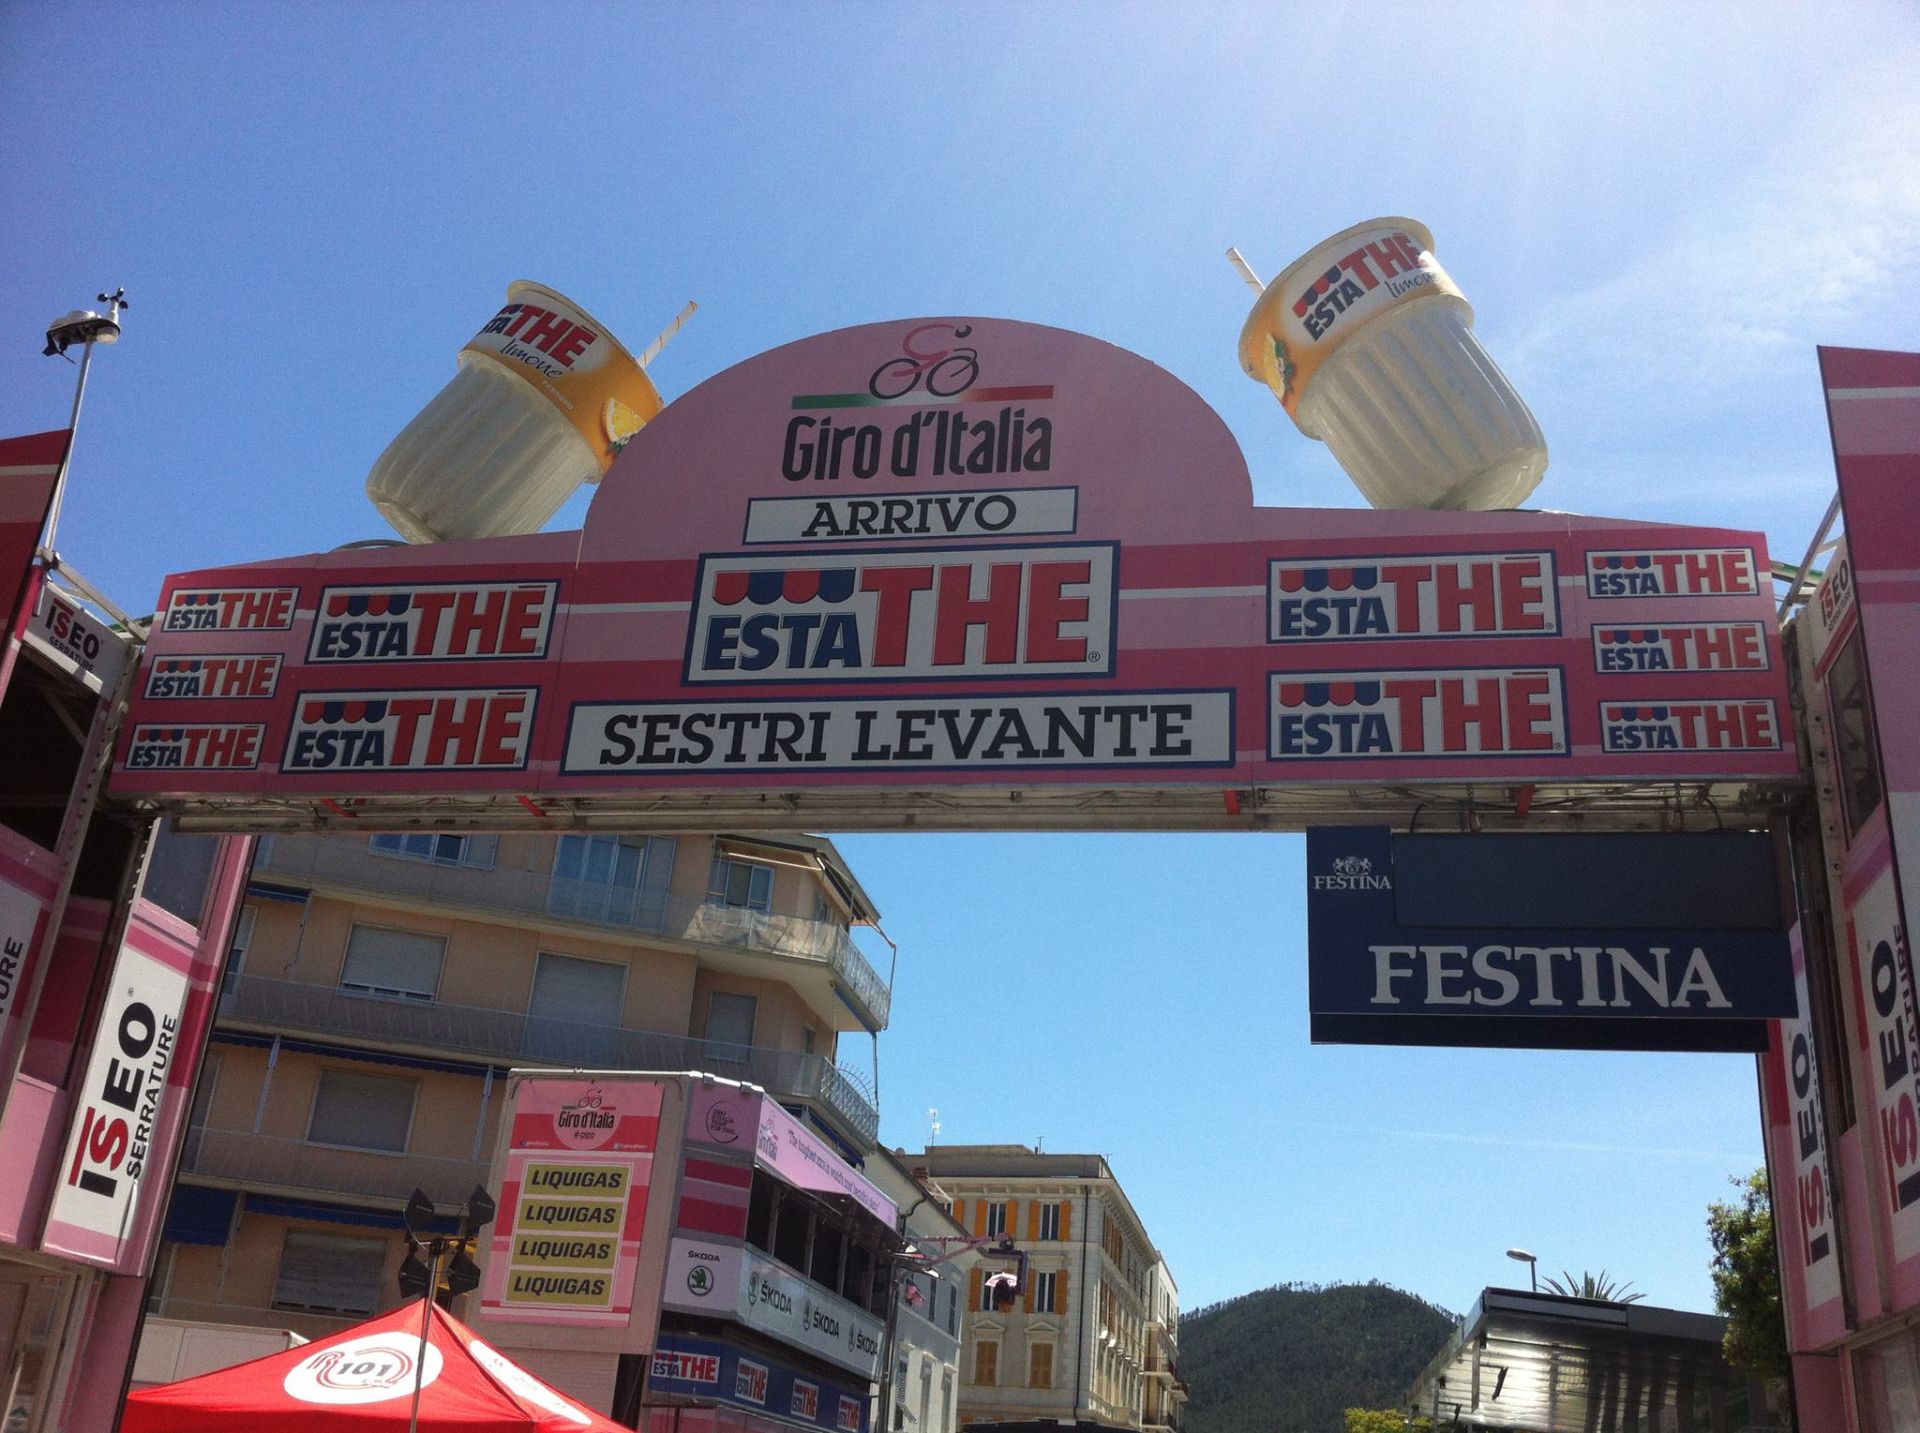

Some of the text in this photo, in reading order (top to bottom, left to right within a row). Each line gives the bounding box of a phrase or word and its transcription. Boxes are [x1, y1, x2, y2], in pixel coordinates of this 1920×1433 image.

[501, 339, 563, 380] limone
[782, 407, 1053, 481] Giro d'Italia
[801, 494, 1017, 537] ARRIVO
[45, 600, 100, 660] ISEO
[48, 636, 95, 672] SERRATURE
[599, 703, 1193, 766] SESTRI LEVANTE
[1314, 875, 1392, 890] FESTINA
[1368, 944, 1733, 1009] FESTINA
[76, 1001, 157, 1199] ISEO
[127, 1013, 177, 1179] SERRATURE
[558, 1111, 580, 1128] Giro
[1792, 1033, 1830, 1264] ISEO
[531, 1170, 622, 1189] LIQUIGAS
[525, 1205, 616, 1224] LIQUIGAS
[519, 1241, 610, 1260] LIQUIGAS
[513, 1276, 605, 1296] LIQUIGAS
[337, 1362, 393, 1376] 101
